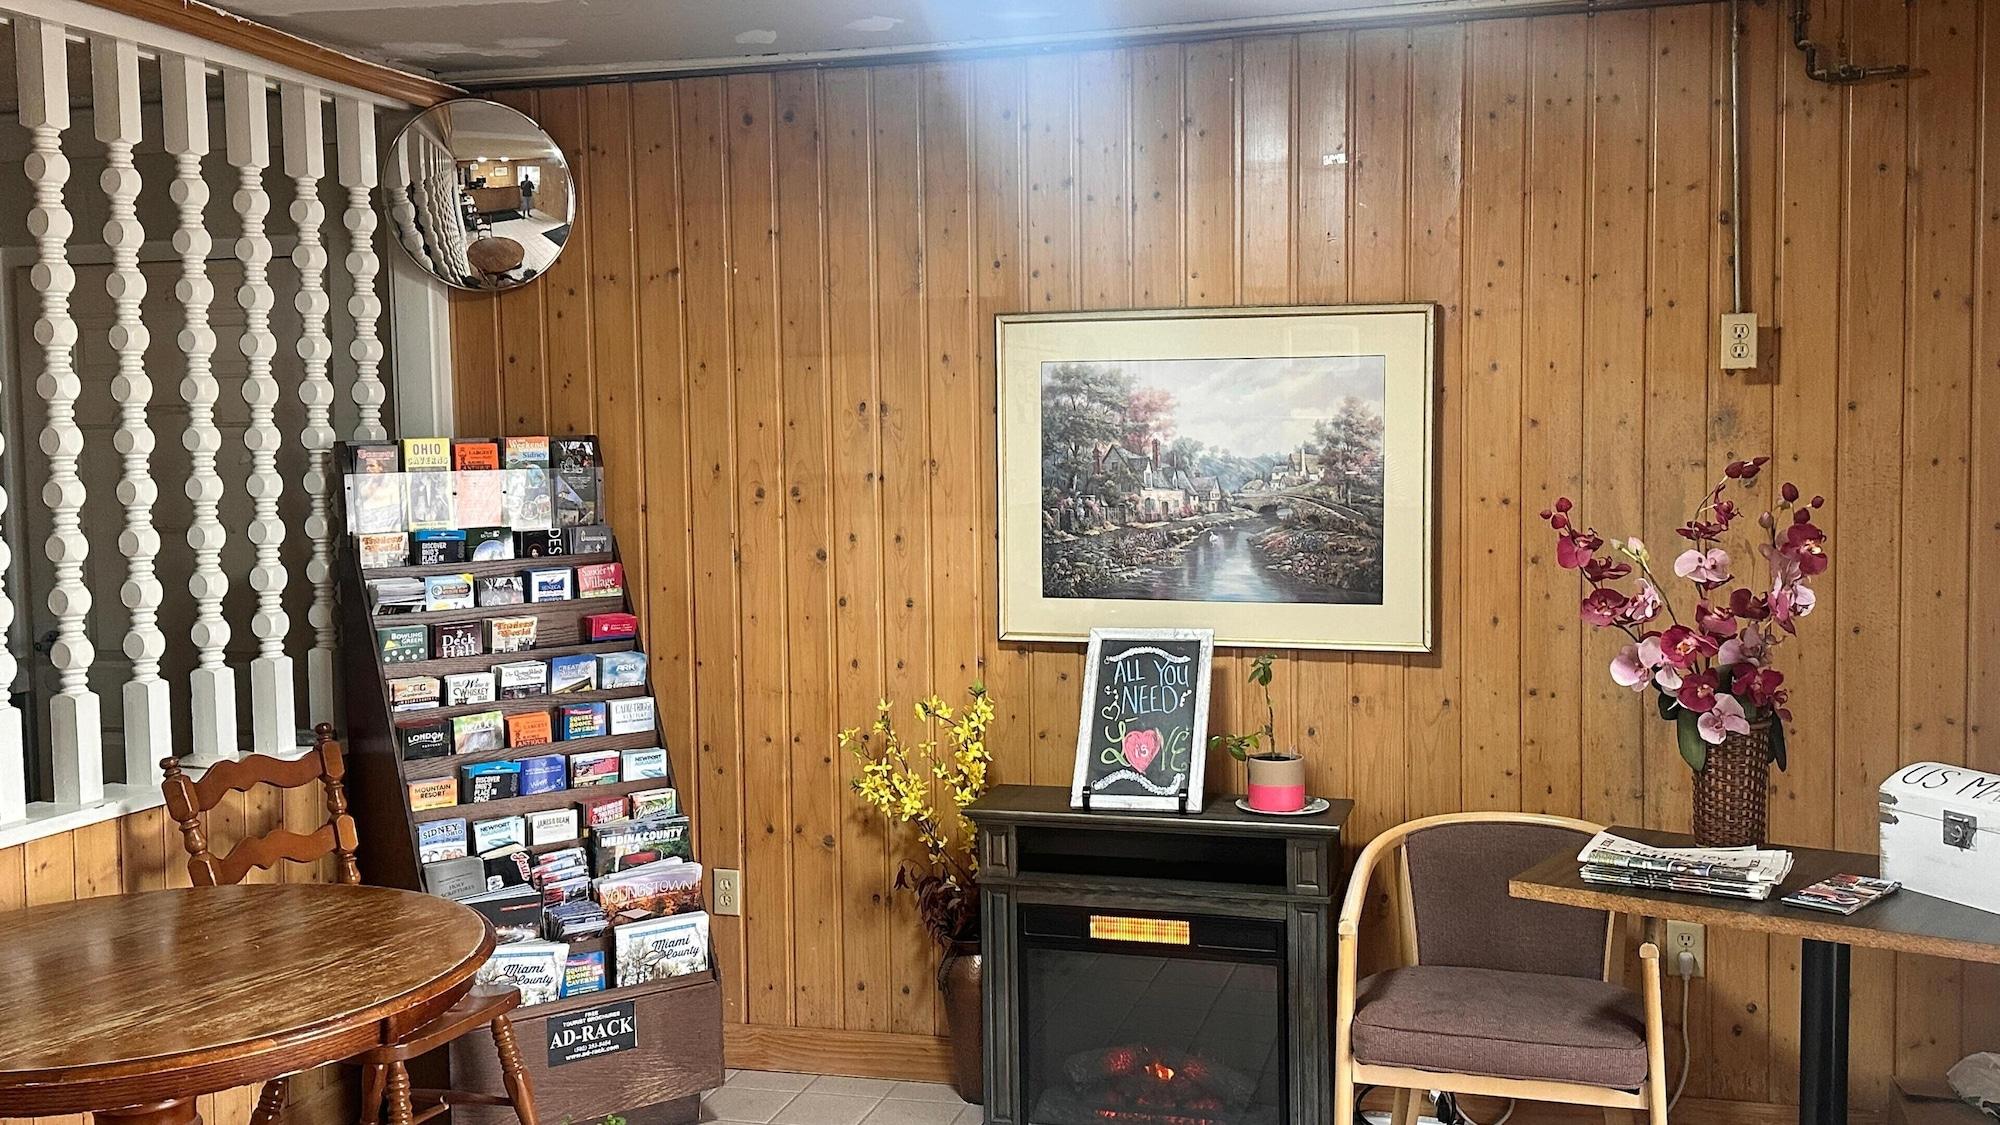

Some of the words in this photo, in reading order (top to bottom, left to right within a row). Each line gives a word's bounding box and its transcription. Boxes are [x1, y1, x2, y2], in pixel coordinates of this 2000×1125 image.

[412, 443, 441, 455] OHIO
[509, 439, 545, 449] Weekend
[408, 456, 448, 465] CAVERNS
[522, 451, 546, 460] Sidney
[583, 576, 615, 589] Village
[391, 631, 423, 641] BOWLING
[401, 637, 423, 645] GREEN
[442, 633, 476, 647] Deck
[616, 664, 636, 672] ARK
[1114, 658, 1145, 685] ALL
[1154, 660, 1190, 688] YOU
[453, 686, 490, 698] WHISKEY
[1121, 684, 1178, 714] NEED
[408, 731, 445, 744] LONDON
[1135, 743, 1149, 758] is
[475, 775, 501, 784] DISCOVER
[1902, 765, 1961, 789] US
[414, 784, 451, 793] MOUNTAIN
[420, 790, 445, 799] RESORT
[474, 788, 491, 796] PLACE
[473, 794, 490, 803] SPACE
[422, 822, 459, 839] SIDNEY
[480, 821, 511, 832] NEWPORT
[445, 829, 463, 838] OHIO
[601, 832, 643, 848] MEDINA
[643, 827, 684, 842] COUNTY
[603, 880, 693, 905] YOUNGSTOWN
[652, 934, 690, 950] Miami
[665, 945, 699, 960] County
[503, 962, 546, 975] Miami
[516, 974, 553, 986] County
[566, 971, 592, 981] BOONE
[563, 1018, 587, 1027] TOURIST
[586, 1010, 621, 1023] BROCHURES
[549, 1015, 634, 1050] AD-RACK
[565, 1044, 620, 1061] www.ad-rack.com
